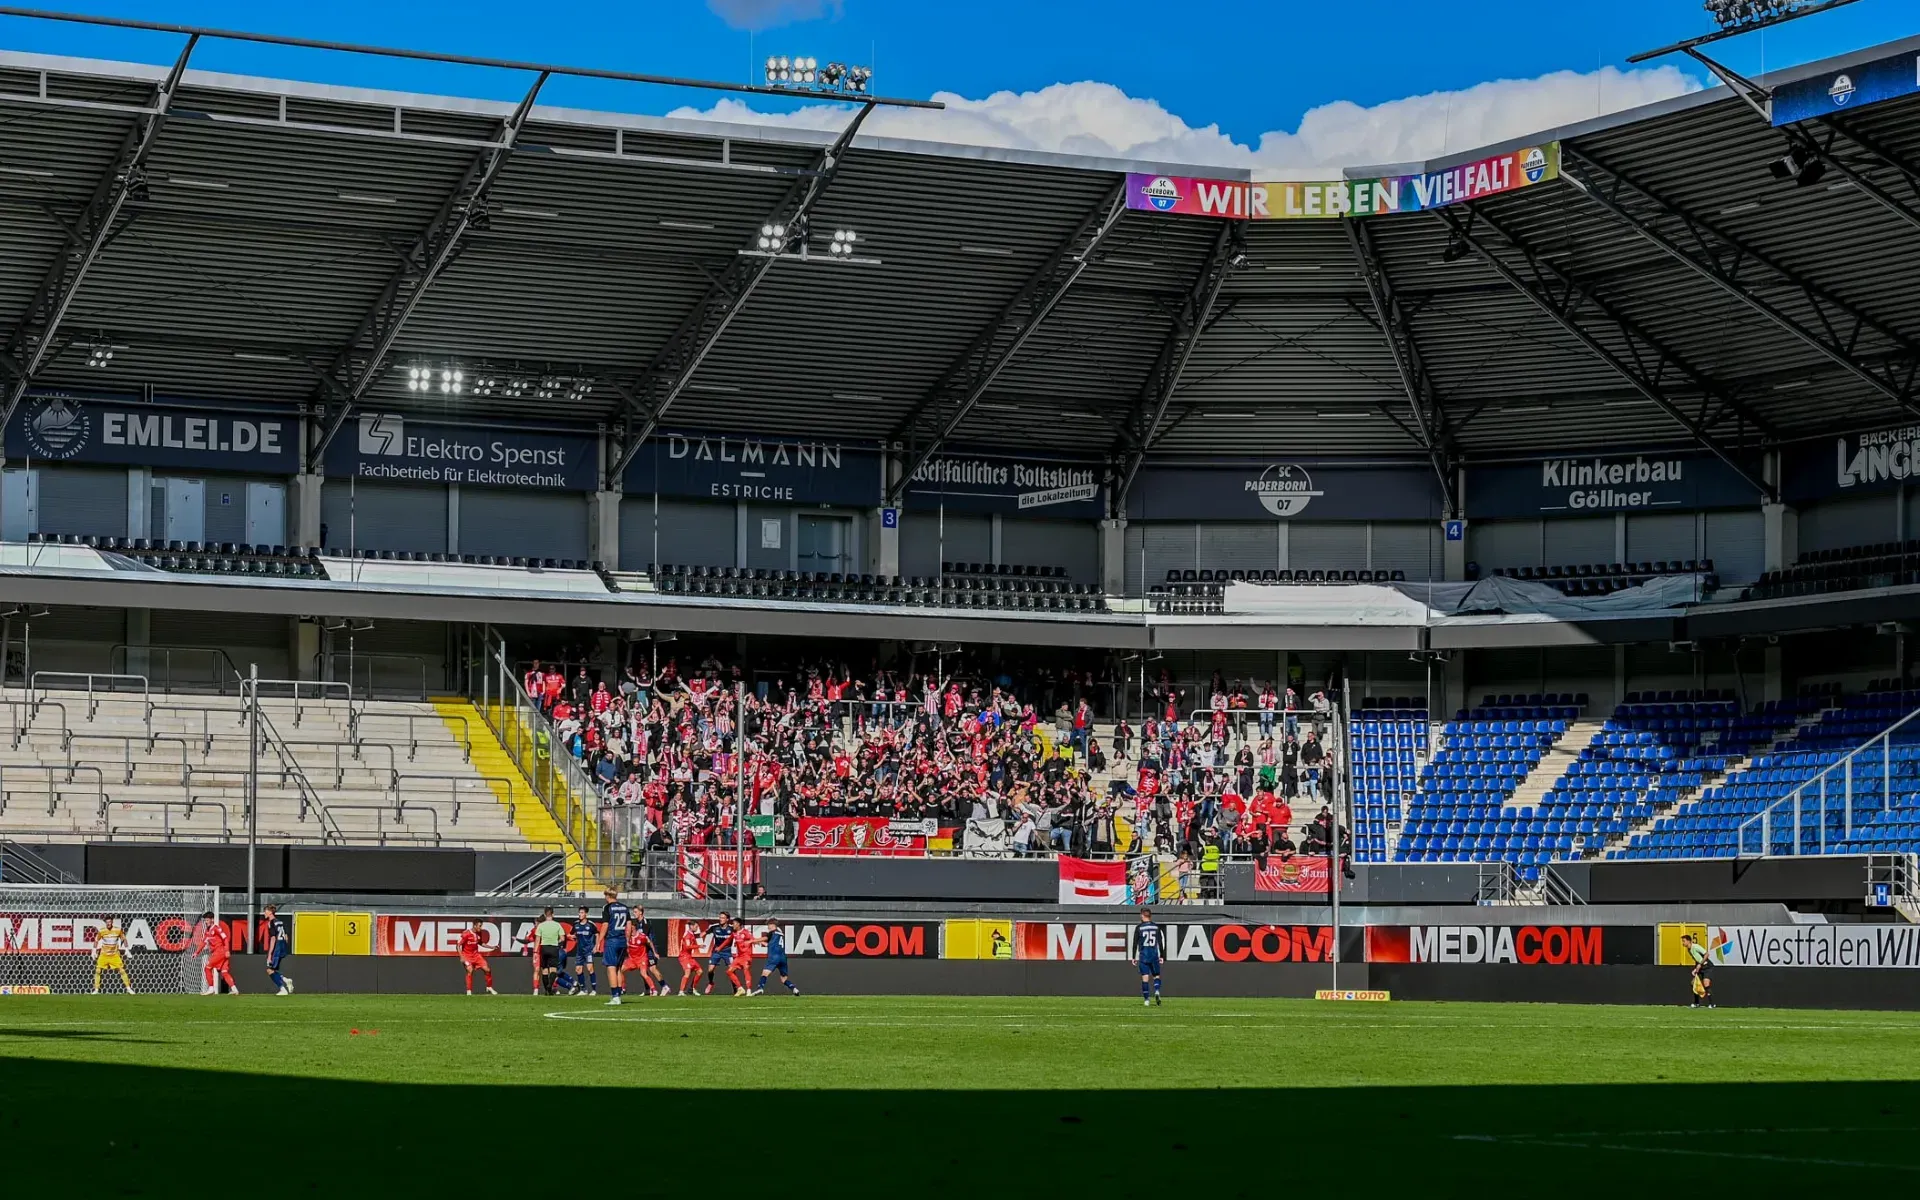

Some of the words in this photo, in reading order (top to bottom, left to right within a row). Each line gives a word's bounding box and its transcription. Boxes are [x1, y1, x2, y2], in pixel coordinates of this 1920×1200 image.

[1141, 187, 1175, 196] PADERBORN
[1159, 180, 1167, 188] SC
[1196, 183, 1271, 216] WIR
[1285, 181, 1399, 215] LEBEN
[1411, 156, 1513, 207] VIELFALT
[103, 412, 282, 454] EMLEI.DE
[406, 436, 484, 461] Elektro
[490, 441, 566, 468] Spenst
[667, 433, 841, 469] DALMANN
[359, 462, 440, 481] Fachbetrieb
[444, 467, 464, 481] für
[468, 469, 566, 487] Elektrotechnik
[1013, 463, 1094, 489] Volksblatt
[1278, 466, 1291, 478] SC
[1542, 456, 1682, 487] Klinkerbau
[711, 483, 793, 500] ESTRICHE
[1244, 480, 1307, 491] PADERBORN
[1021, 494, 1035, 505] die
[1037, 487, 1092, 504] Lokalzeitung
[1277, 499, 1292, 510] 07
[1568, 490, 1652, 509] Göllner
[885, 512, 894, 525] 3
[1449, 525, 1459, 537] 4
[1877, 886, 1887, 902] H
[348, 921, 357, 935] 3
[614, 912, 627, 931] 22
[0, 917, 269, 952] MEDACM
[395, 920, 608, 953] MEDIA
[1142, 930, 1157, 947] 25
[1692, 932, 1698, 944] 5
[1409, 925, 1603, 965] MEDIACOM
[1319, 991, 1346, 1000] WEST
[1354, 991, 1386, 1000] LOTTO
